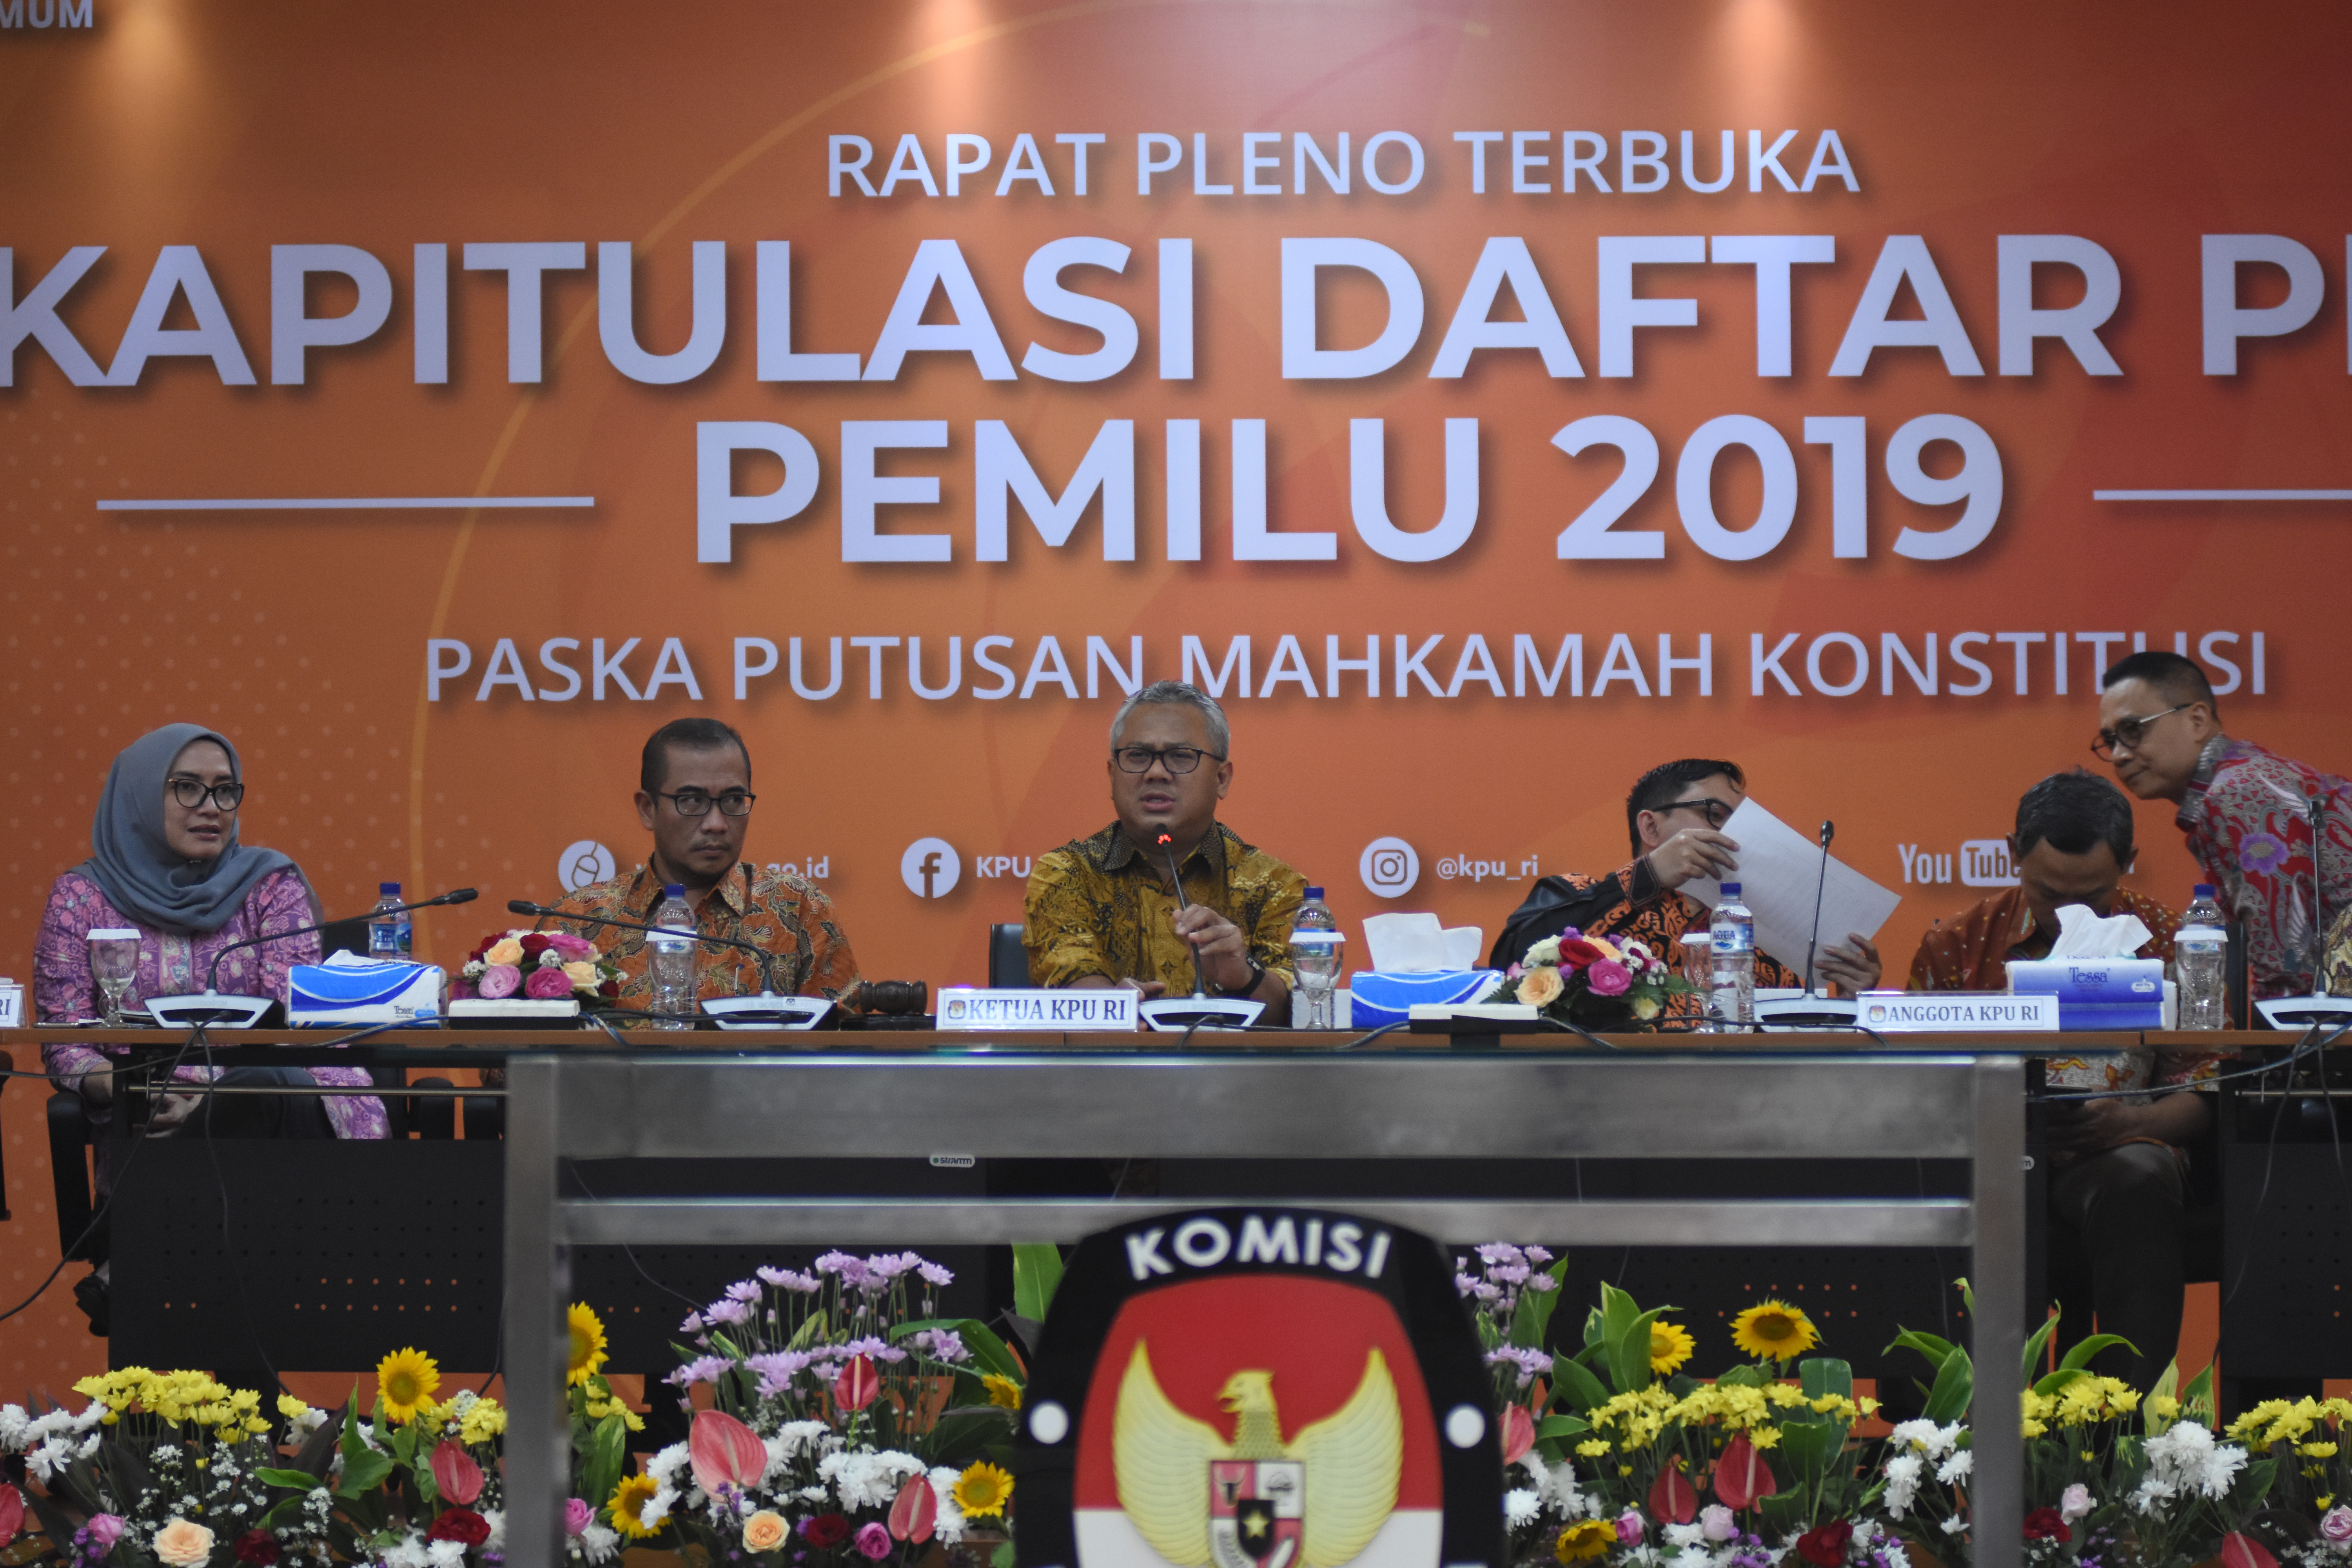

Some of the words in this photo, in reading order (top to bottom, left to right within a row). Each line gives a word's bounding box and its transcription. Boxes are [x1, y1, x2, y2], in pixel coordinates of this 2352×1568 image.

[0, 0, 93, 29] MUM
[829, 132, 1106, 197] RAPAT
[1137, 131, 1426, 196] PLENO
[1453, 129, 1860, 194] TERBUKA
[0, 236, 1194, 387] KAPITULASI
[1280, 234, 2124, 380] DAFTAR
[2201, 234, 2352, 376] P
[697, 417, 1480, 563] PEMILU
[1551, 414, 2004, 561] 2019
[428, 637, 703, 701] PASKA
[734, 635, 1143, 701] PUTUSAN
[1181, 633, 1712, 698] MAHKAMAH
[976, 856, 1031, 878] KPU
[1437, 853, 1538, 882] @kpu_ri
[1898, 844, 1952, 884] You
[1713, 930, 1735, 940] AQUA
[2069, 967, 2108, 983] Tessa
[0, 999, 11, 1015] I
[969, 999, 1044, 1020] KETUA
[1051, 999, 1096, 1020] KPU
[1103, 999, 1126, 1020] RI
[1888, 1006, 1975, 1022] ANGGOTA
[1980, 1006, 2015, 1021] KPU
[2022, 1005, 2039, 1021] RI
[1124, 1214, 1392, 1281] KOMISI
